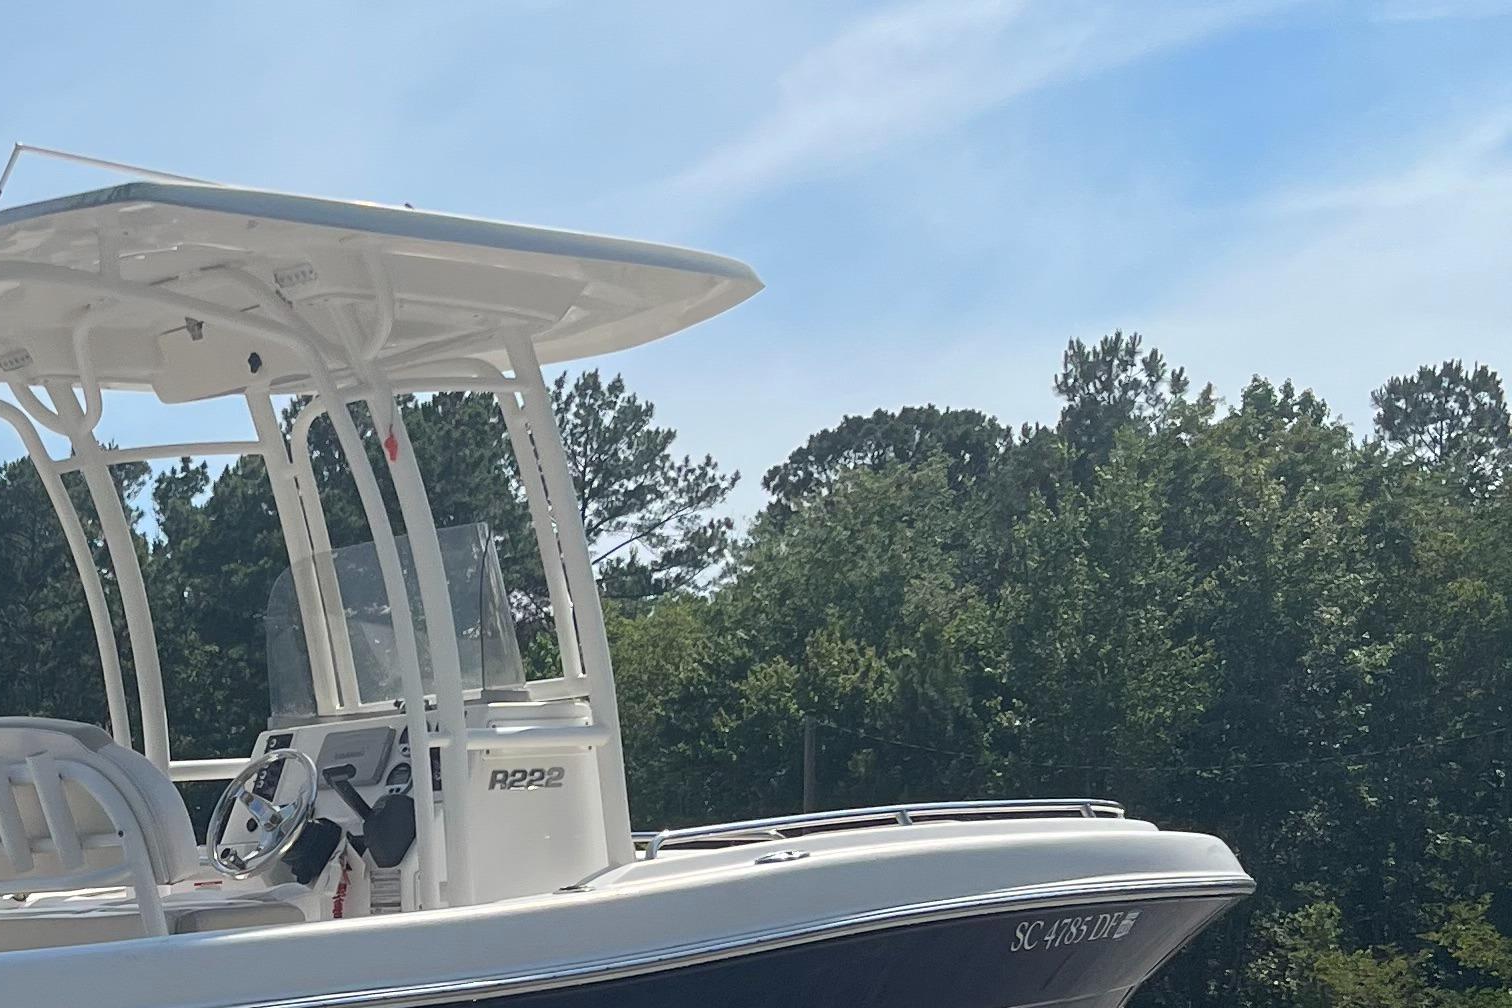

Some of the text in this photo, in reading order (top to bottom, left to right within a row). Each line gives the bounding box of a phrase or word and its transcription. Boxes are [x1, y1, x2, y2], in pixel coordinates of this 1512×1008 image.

[488, 766, 565, 791] R222
[1010, 921, 1044, 952] SC
[1043, 915, 1092, 950] 4785
